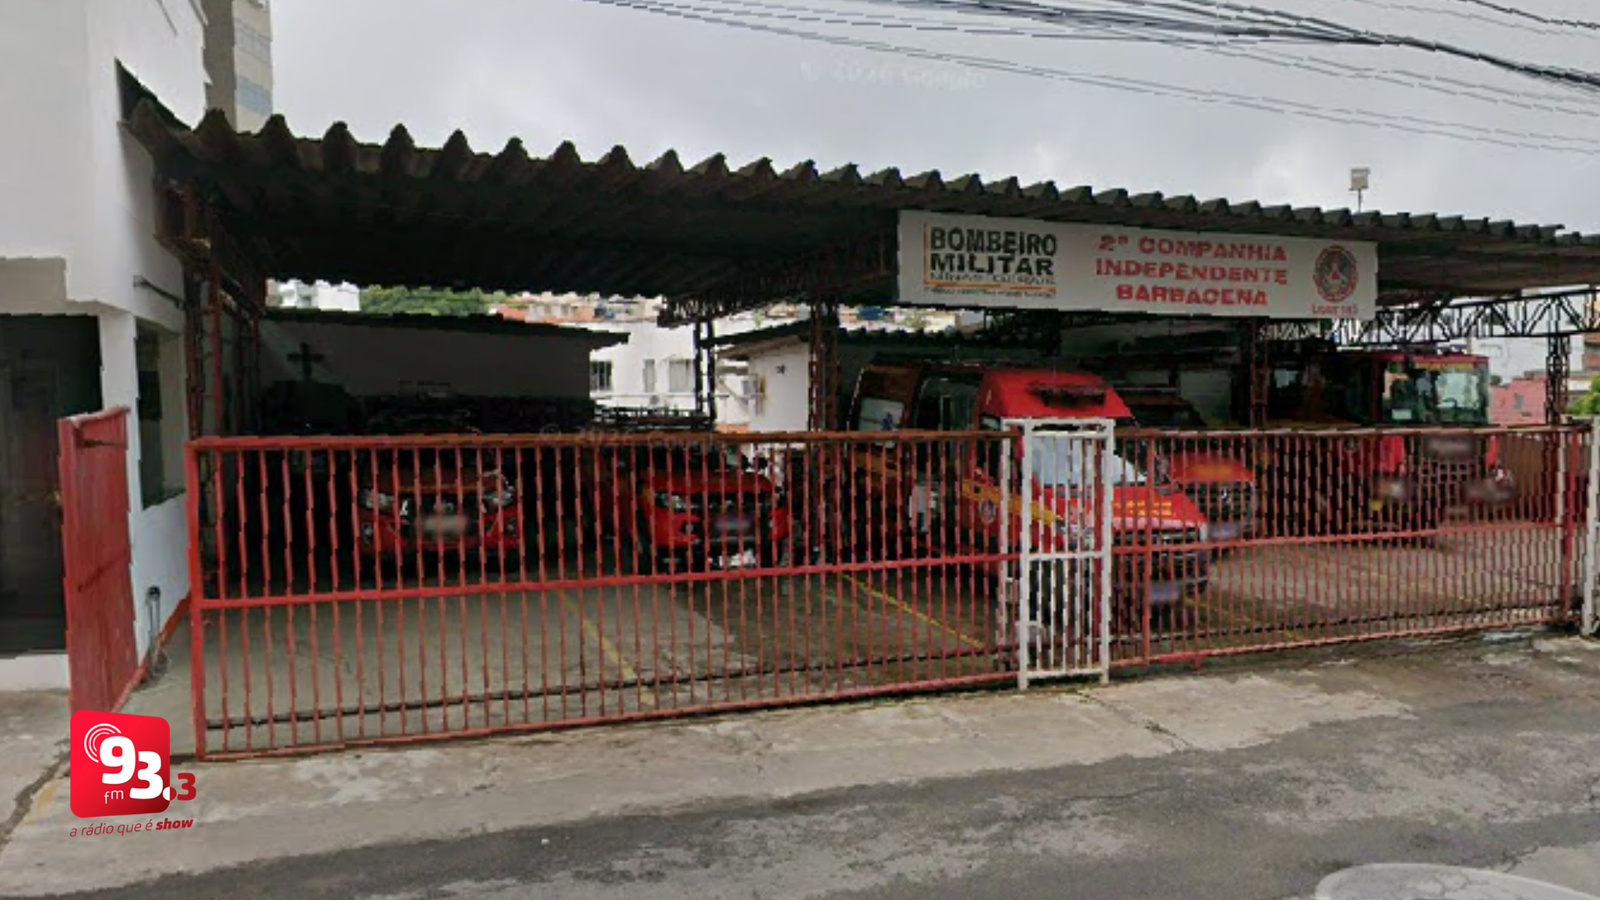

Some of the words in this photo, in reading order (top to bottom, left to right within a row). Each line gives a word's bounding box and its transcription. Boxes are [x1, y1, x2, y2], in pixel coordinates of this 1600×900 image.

[930, 226, 1057, 256] BOMBEIRO
[1138, 236, 1288, 261] COMPANHIA
[930, 253, 1054, 276] MILITAR
[1095, 257, 1288, 285] INDEPENDENTE
[1115, 283, 1269, 305] BARBACENA
